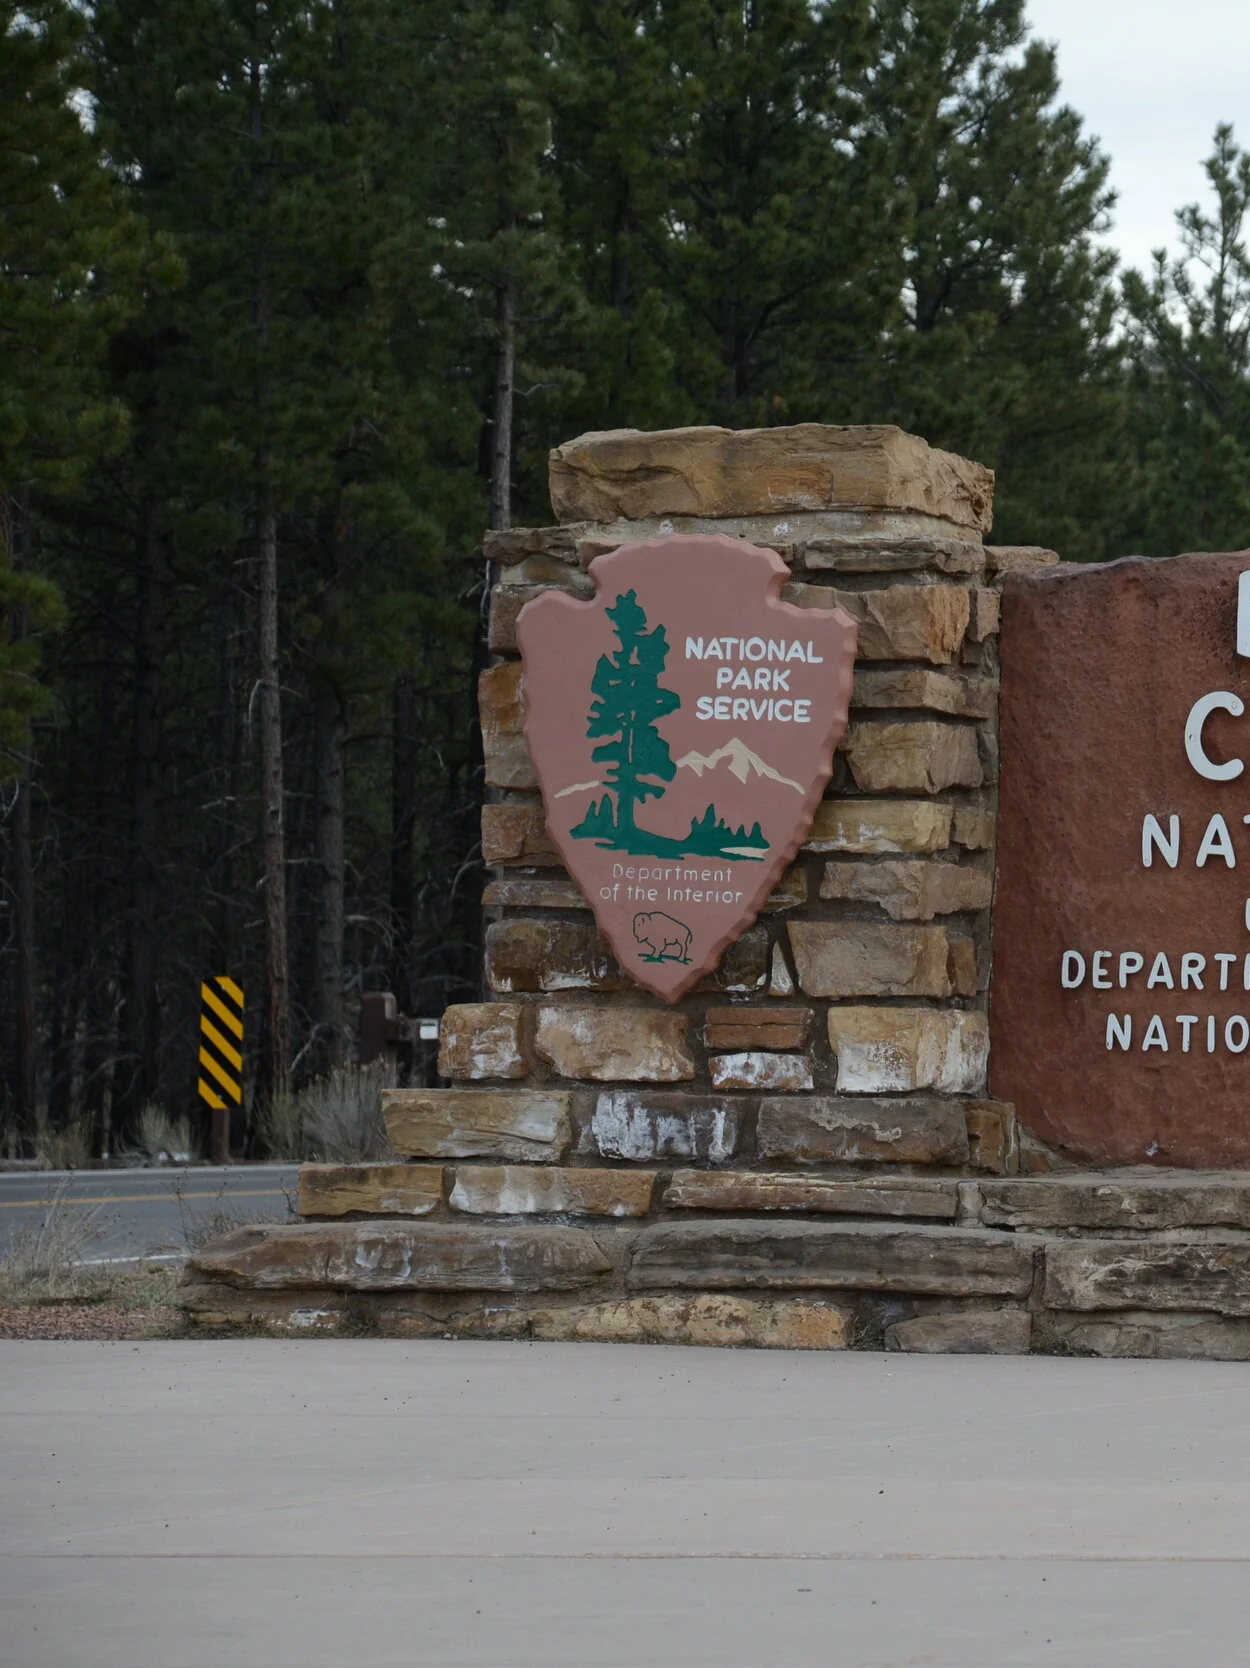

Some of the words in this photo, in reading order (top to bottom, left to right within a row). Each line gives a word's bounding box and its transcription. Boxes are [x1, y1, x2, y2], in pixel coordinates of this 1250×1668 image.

[685, 636, 824, 664] NATIONAL
[716, 667, 792, 692] PARK
[695, 695, 812, 723] SERVICE
[612, 863, 733, 883] Department
[599, 883, 620, 902] of
[627, 885, 658, 902] the
[667, 887, 743, 904] Interior
